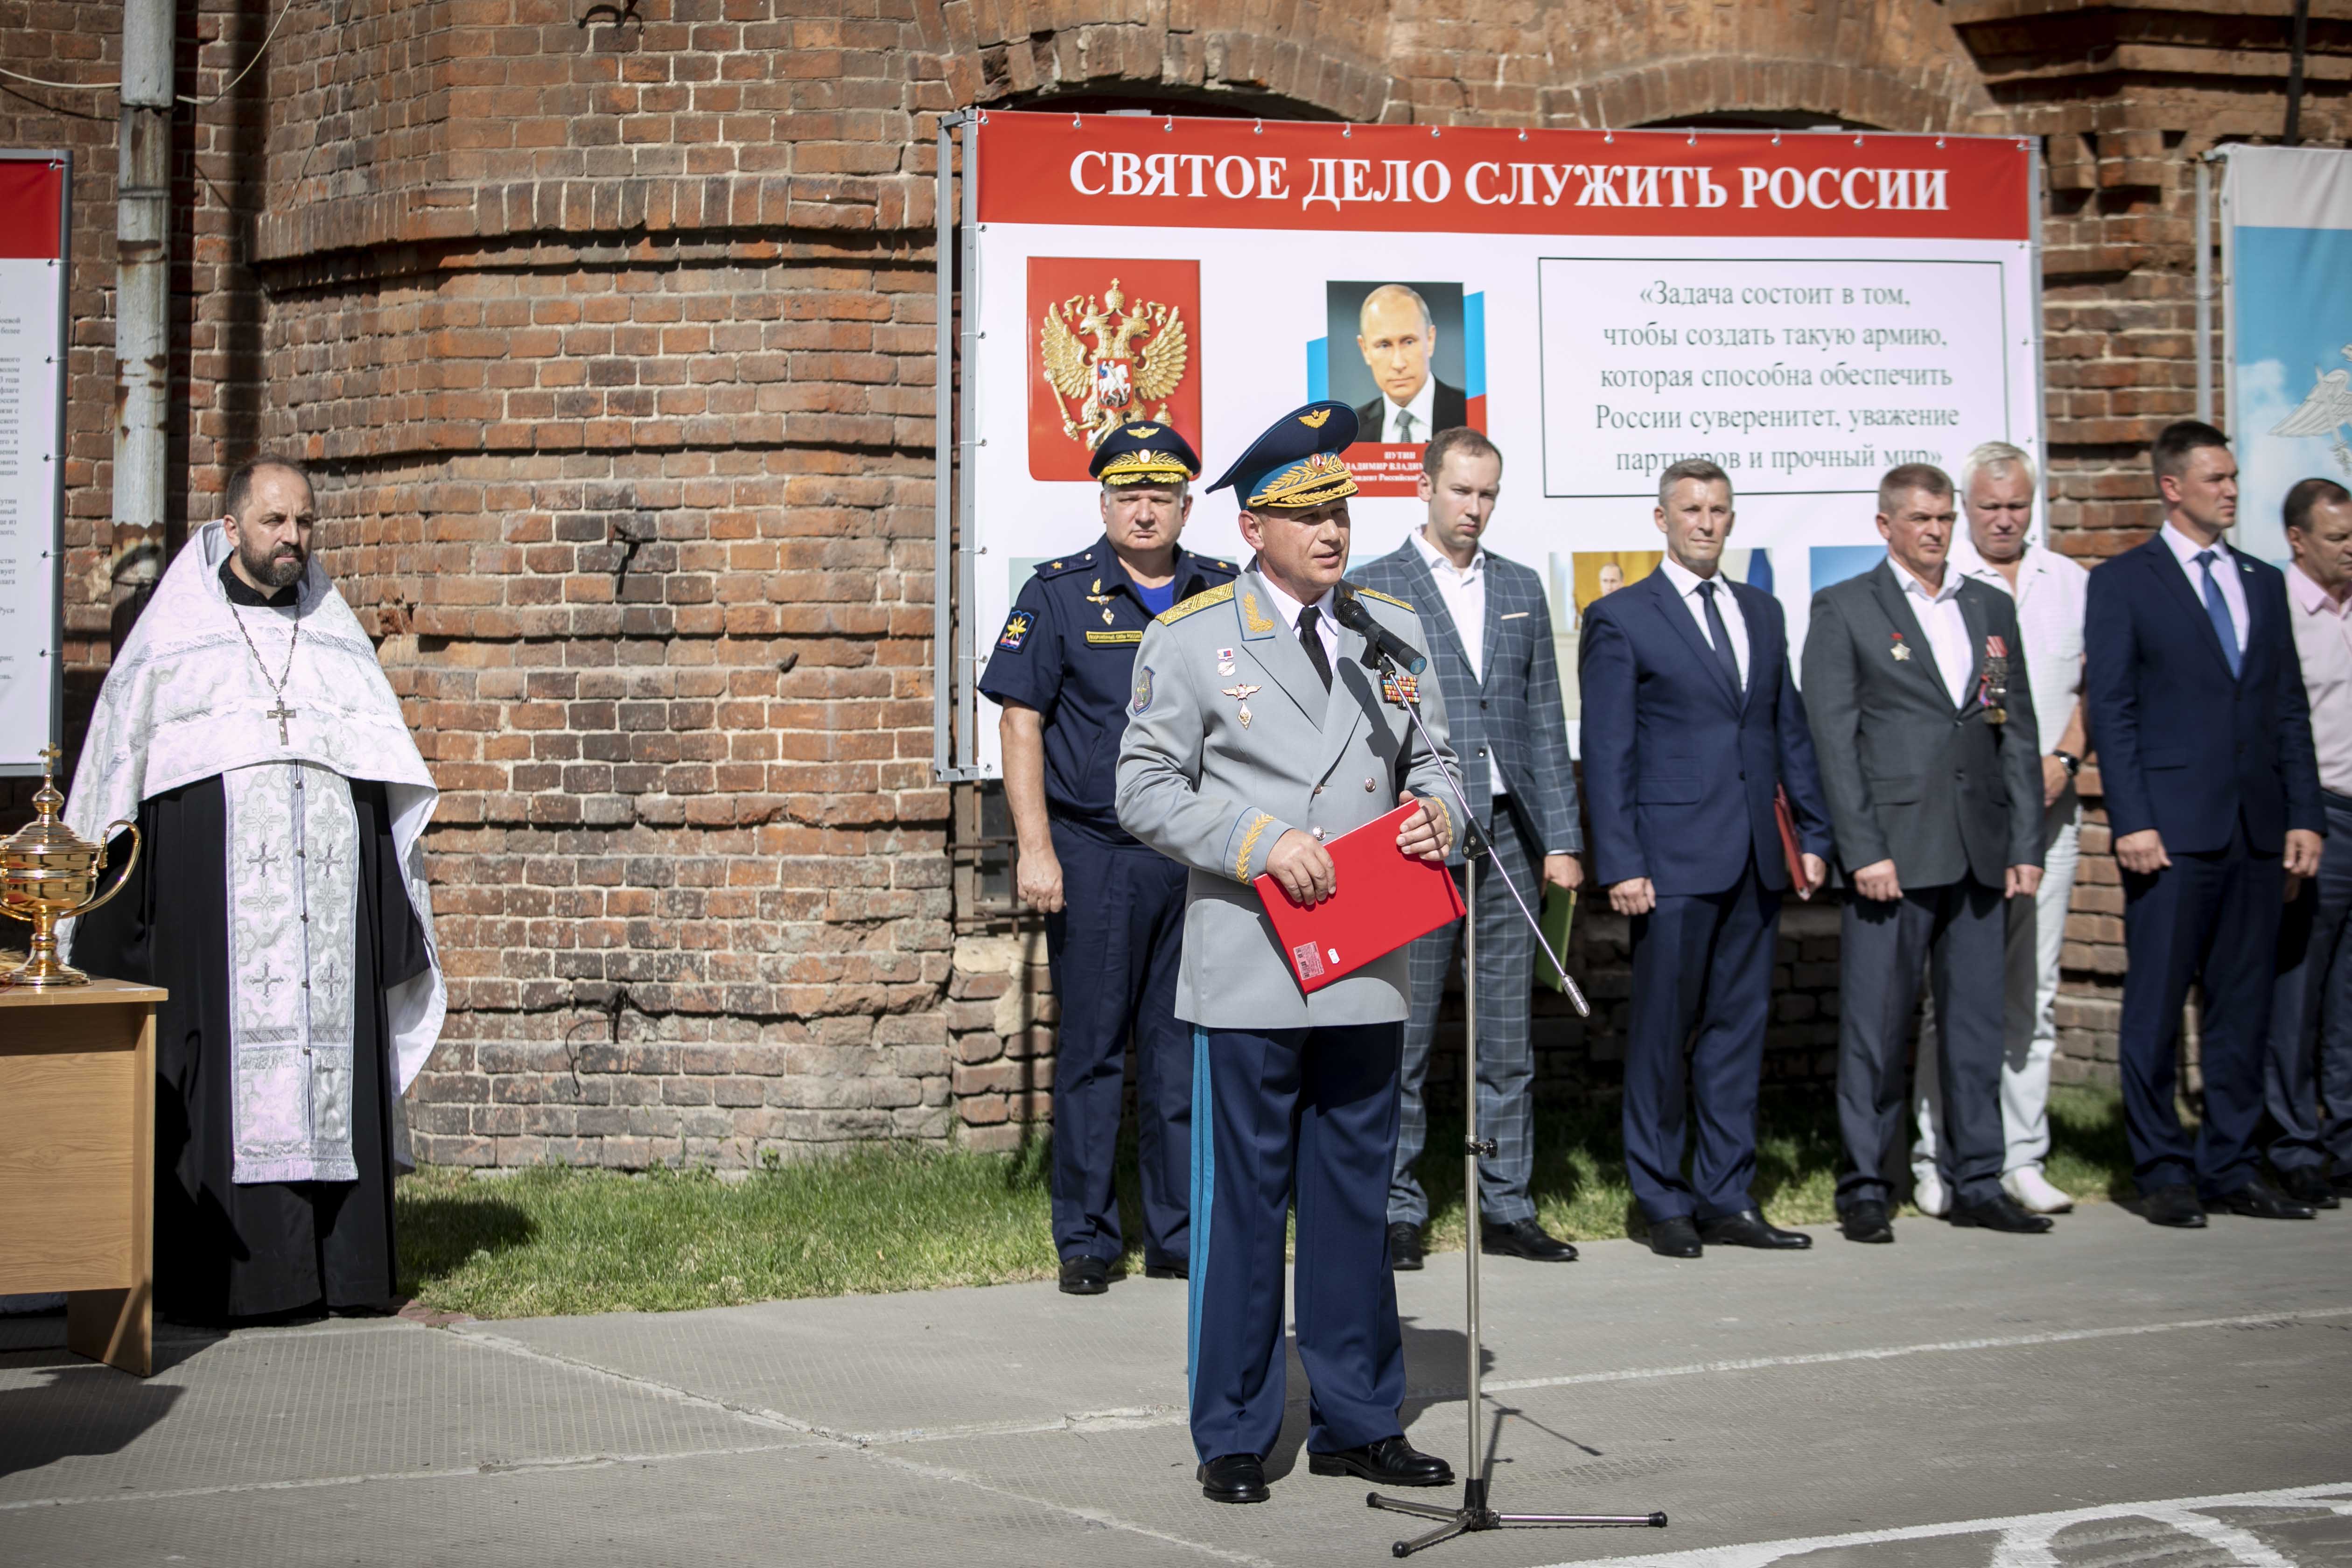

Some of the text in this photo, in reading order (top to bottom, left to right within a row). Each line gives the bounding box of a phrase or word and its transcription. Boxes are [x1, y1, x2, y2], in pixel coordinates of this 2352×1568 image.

[1070, 151, 1949, 211] СВЯТОЕ ДЕЛО СЛУЖИТЬ РОССИИ
[1640, 280, 1911, 306] «Задача состоит в том,
[1603, 321, 1947, 351] чтобы создать такую армию,
[1601, 361, 1953, 394] которая способна обеспечить
[1596, 404, 1960, 434] России суверенитет, уважение
[1344, 462, 1388, 471] ЛАДИМИР
[1749, 451, 1763, 469] и
[1771, 444, 1875, 475] прочный
